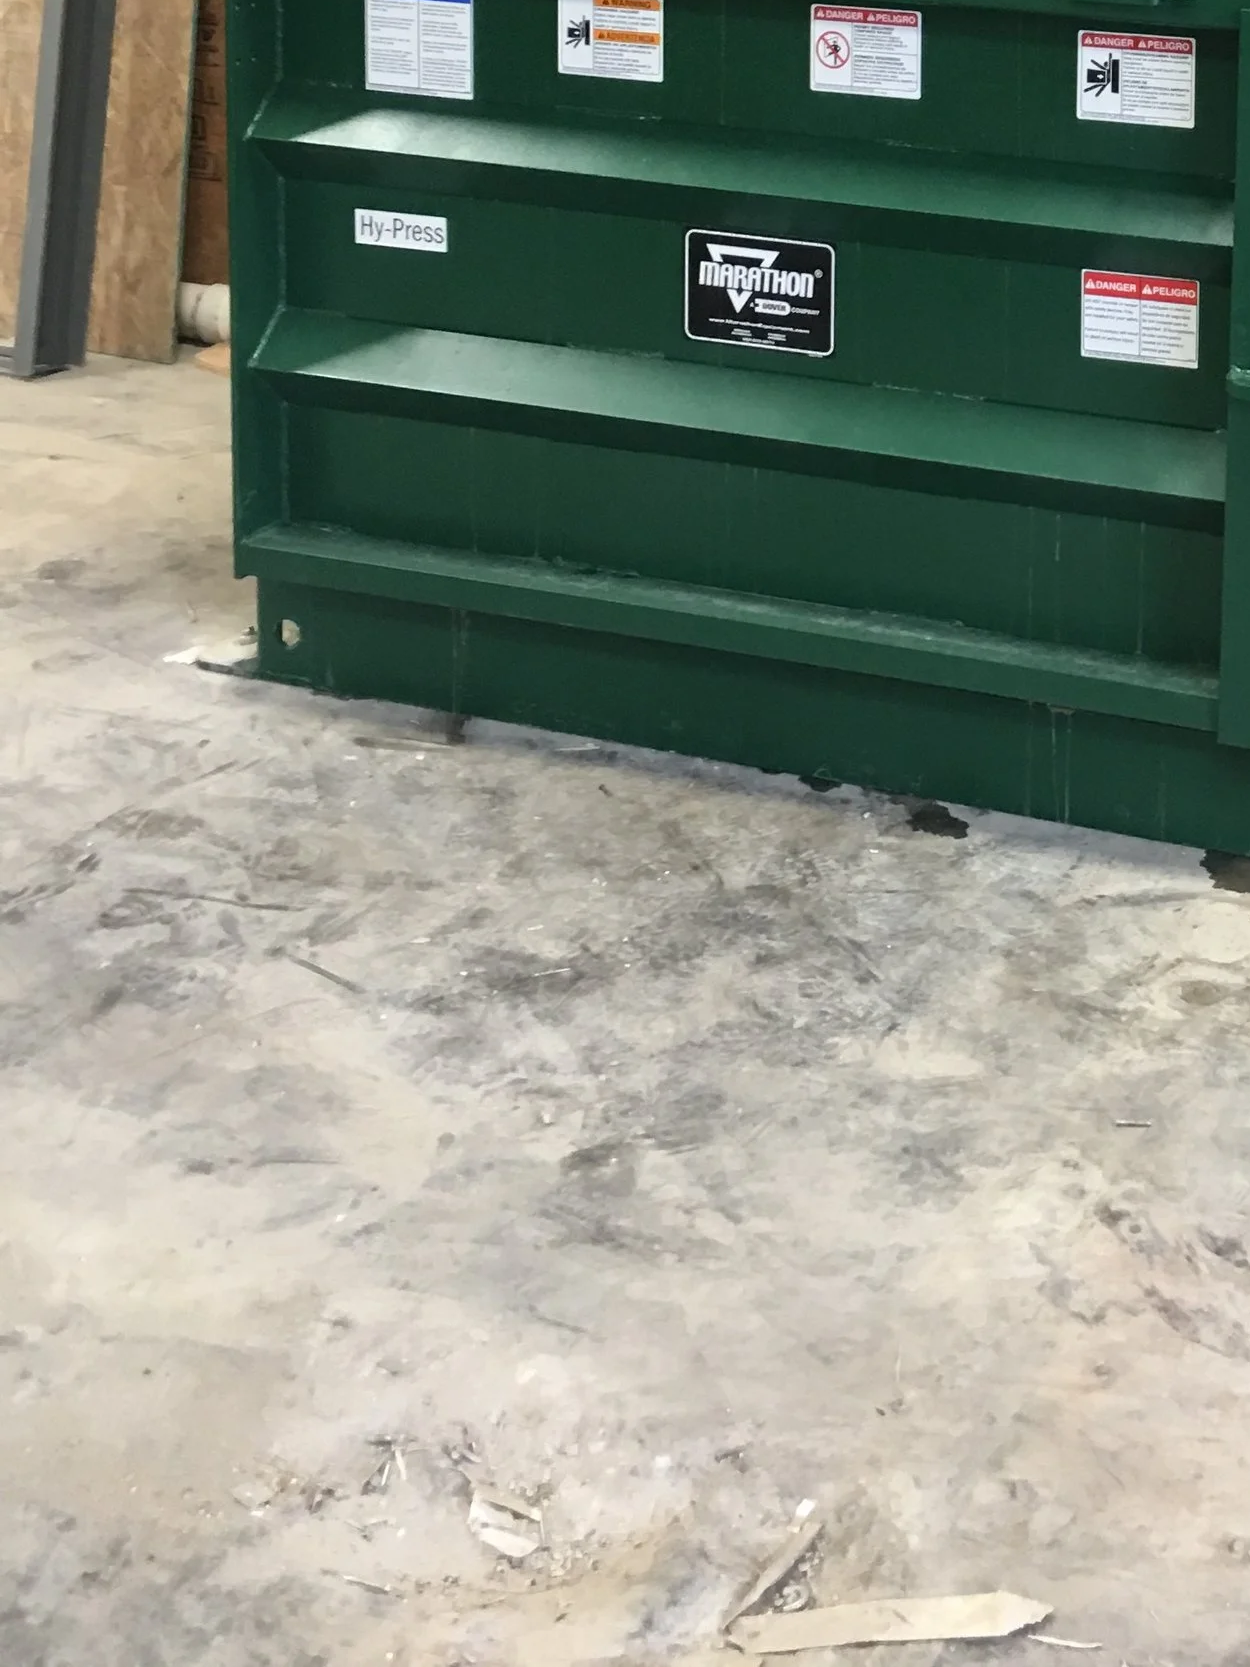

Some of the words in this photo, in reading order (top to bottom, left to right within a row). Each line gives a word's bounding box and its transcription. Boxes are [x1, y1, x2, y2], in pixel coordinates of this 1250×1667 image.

[826, 10, 864, 20] DANGER
[876, 14, 916, 23] PELIGRO
[1094, 37, 1134, 47] DANGER
[1148, 40, 1190, 51] PELIGRO
[361, 215, 444, 243] Hy-Press
[699, 261, 814, 298] MARATHON
[1096, 281, 1136, 292] DANGER
[1153, 286, 1196, 298] PELIGRO
[762, 303, 787, 312] DOVER
